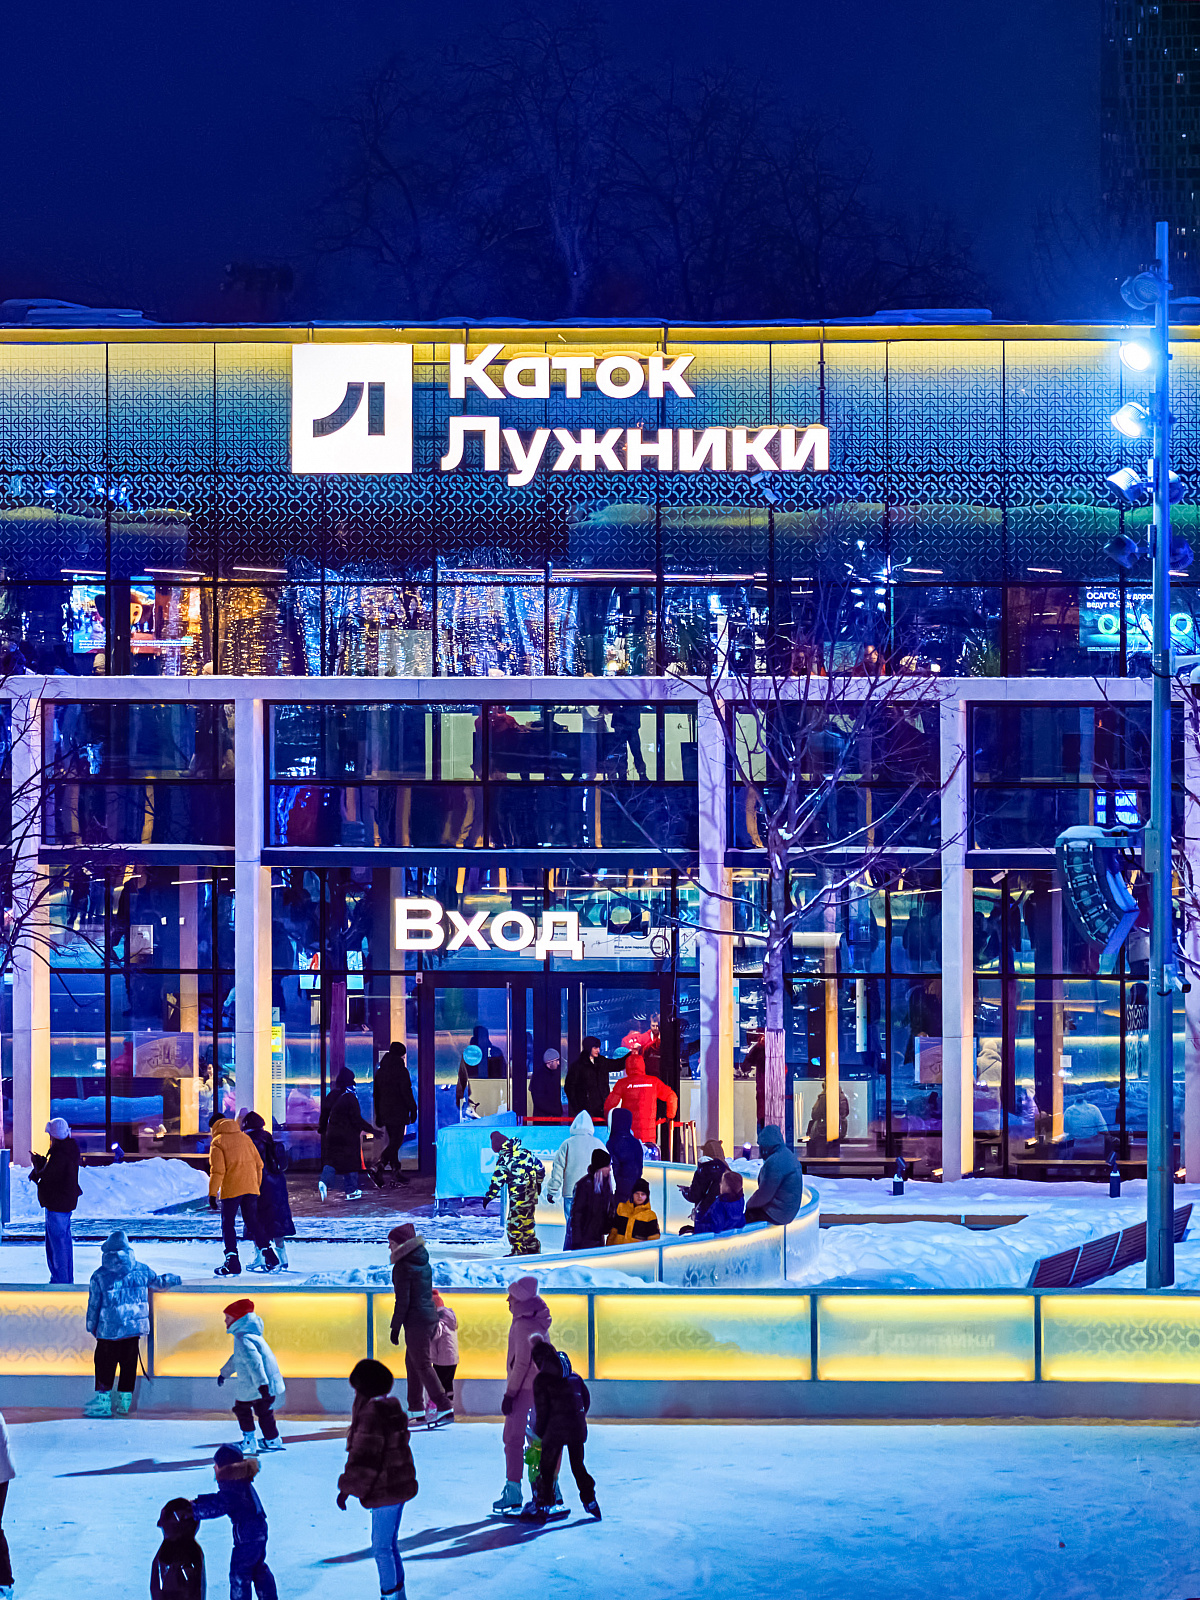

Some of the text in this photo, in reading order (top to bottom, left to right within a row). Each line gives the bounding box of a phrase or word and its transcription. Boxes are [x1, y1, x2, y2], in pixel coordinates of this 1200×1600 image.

[450, 343, 696, 399] Каток
[441, 416, 830, 487] Лужники
[1086, 591, 1117, 600] ОСАГО:
[1086, 601, 1108, 610] ведут
[394, 898, 585, 961] Вход
